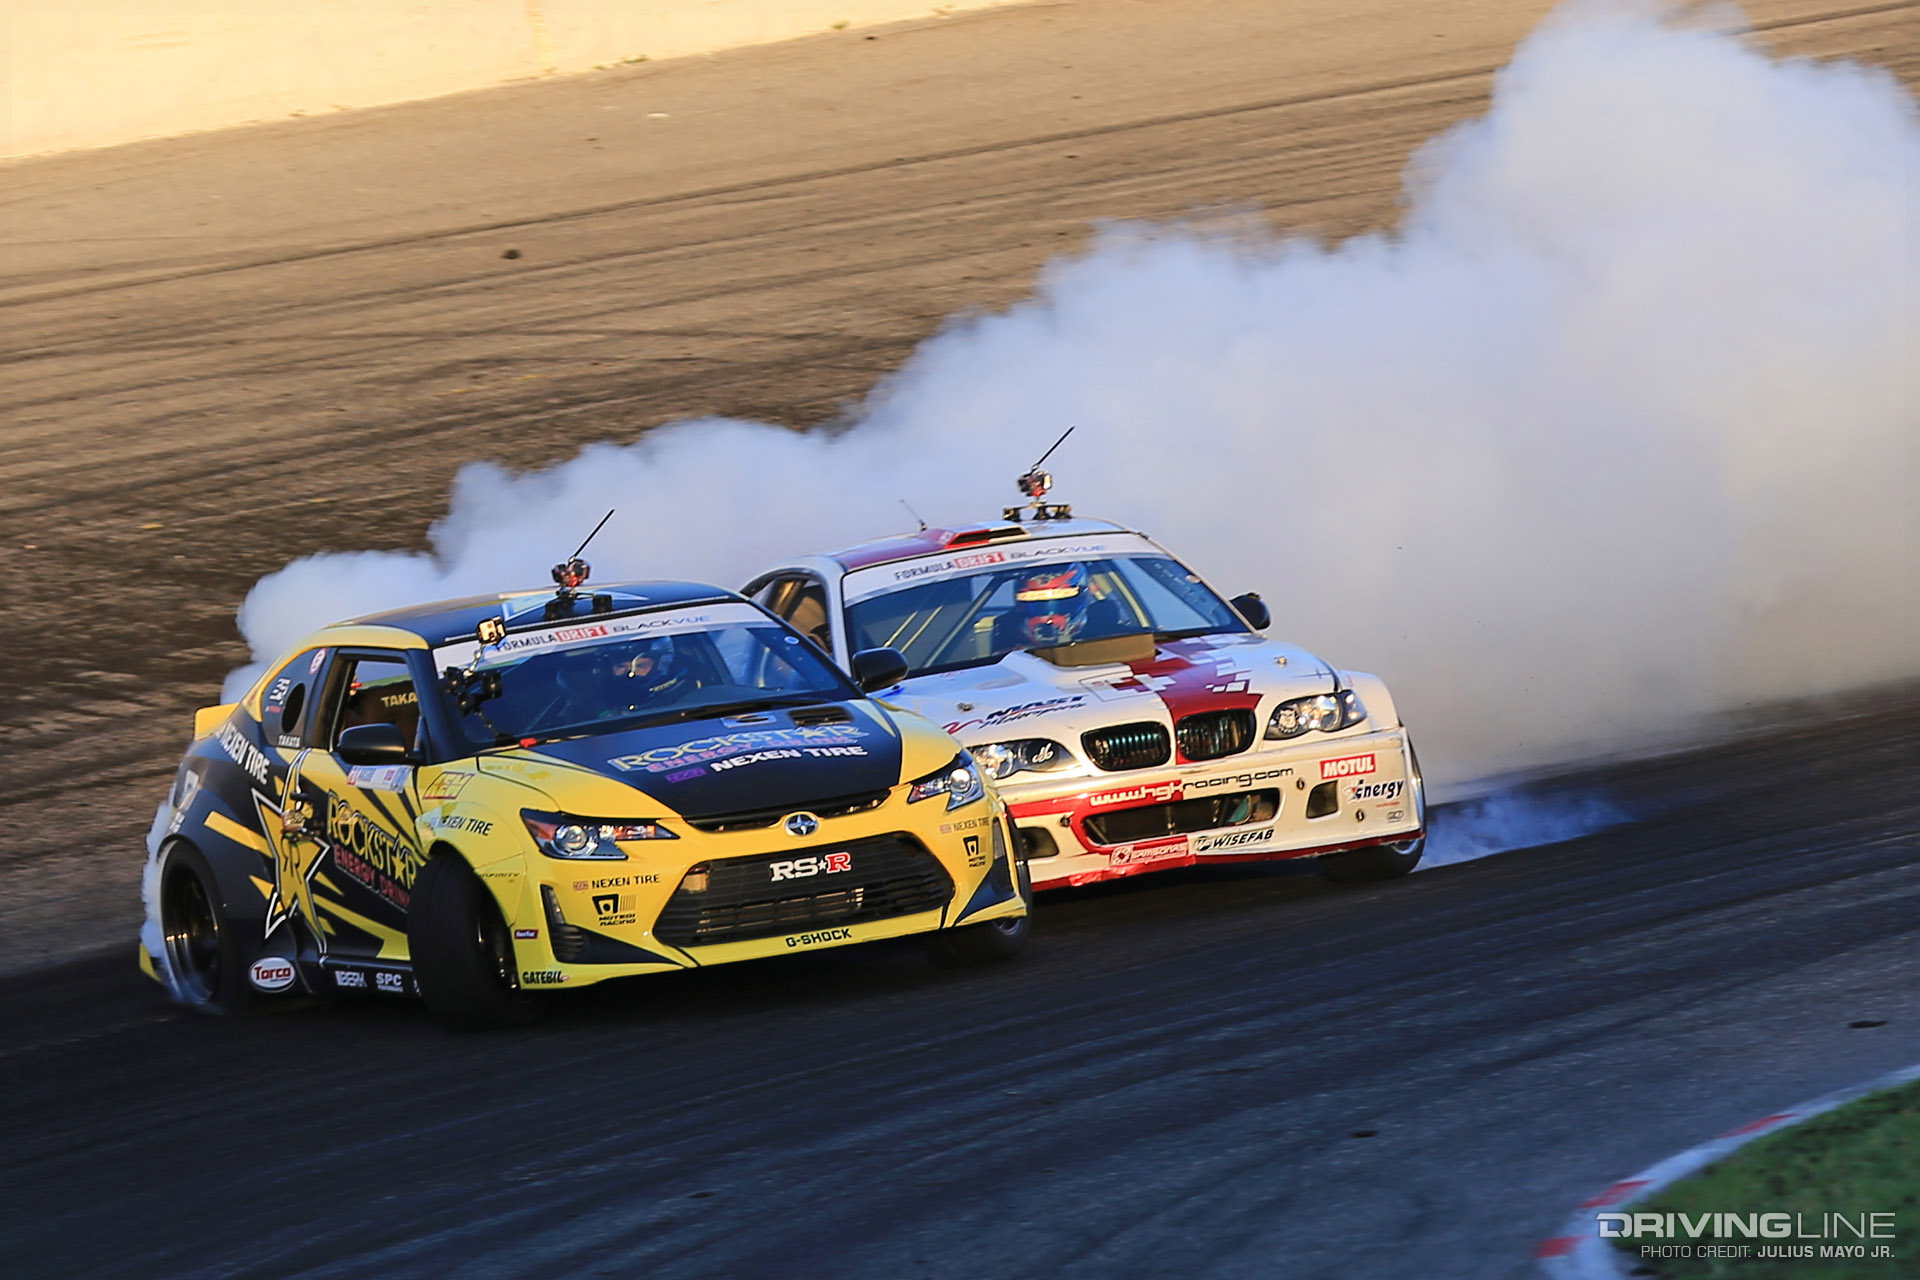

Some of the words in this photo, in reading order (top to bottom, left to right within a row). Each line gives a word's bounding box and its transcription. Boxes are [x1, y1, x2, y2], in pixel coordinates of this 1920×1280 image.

[960, 553, 1001, 568] DRIFT
[501, 635, 556, 650] ORMULA
[558, 628, 606, 641] DRIFT
[219, 722, 250, 765] NEXEN
[244, 744, 270, 785] TIRE
[710, 748, 801, 772] NEXEN
[804, 746, 868, 757] TIRE
[1322, 756, 1374, 778] MOTUL
[1090, 767, 1294, 806] www.hgkracing.com
[465, 817, 494, 836] TIRE
[1213, 829, 1275, 849] WISEFAB
[591, 878, 630, 889] NEXEN
[634, 874, 660, 884] TIRE
[785, 928, 852, 948] G-SHOCK
[255, 966, 291, 980] Torco
[376, 973, 402, 987] SPC
[522, 971, 564, 985] GATEBIL
